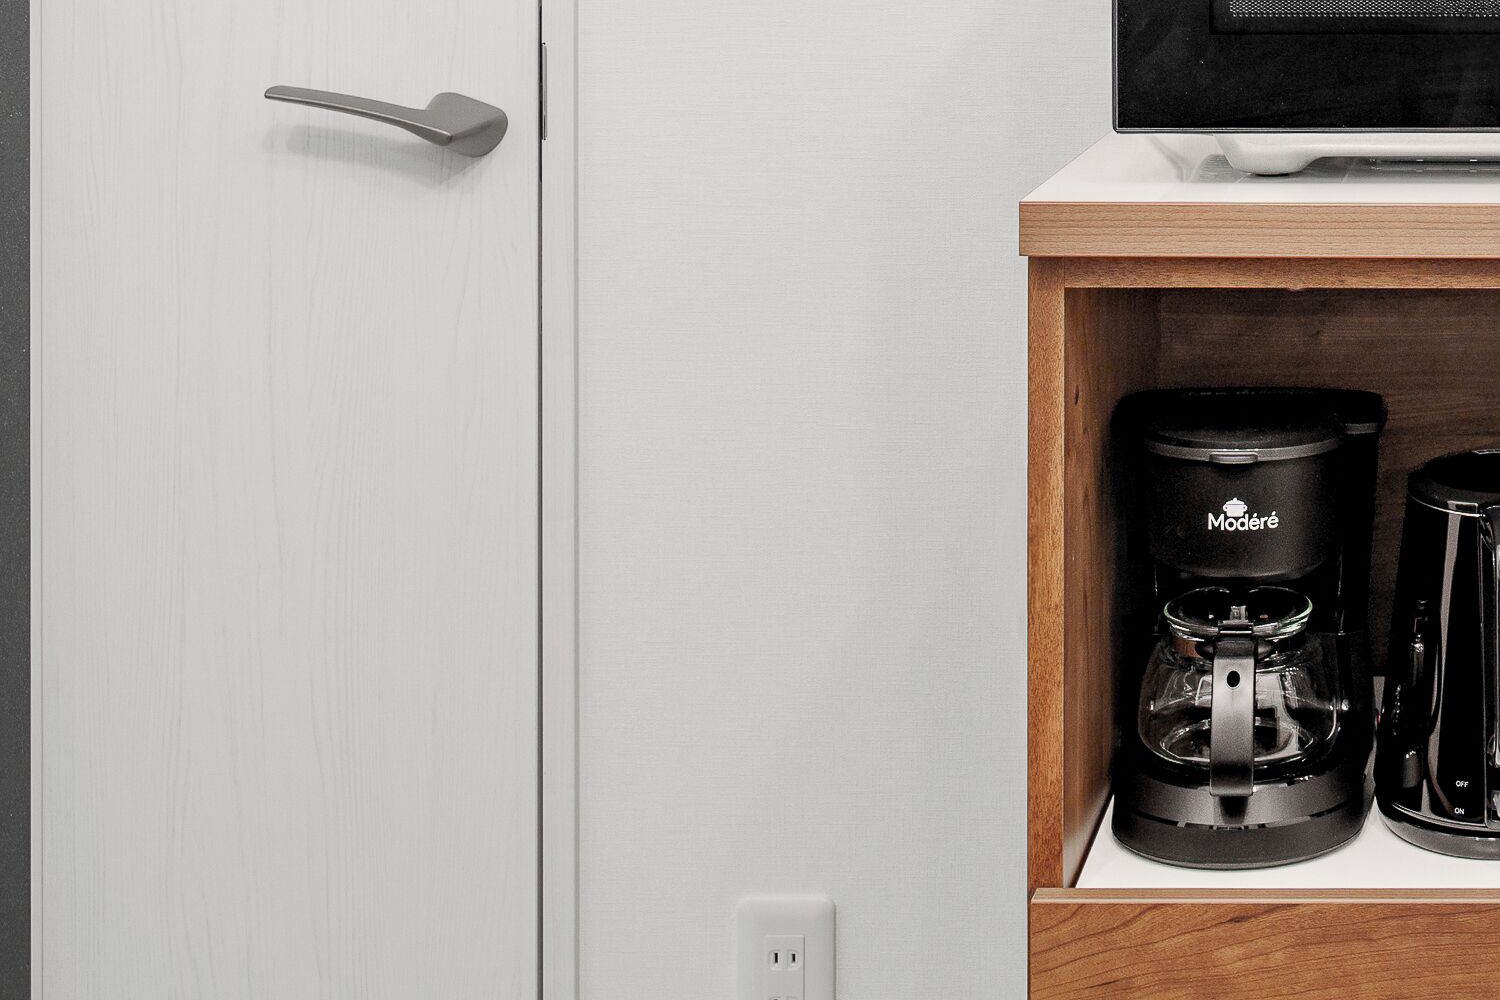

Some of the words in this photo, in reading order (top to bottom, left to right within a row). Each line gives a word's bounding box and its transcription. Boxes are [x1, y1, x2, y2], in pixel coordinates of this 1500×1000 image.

[1207, 510, 1280, 531] Modéré
[1455, 780, 1470, 788] OFF
[1454, 807, 1465, 815] ON
